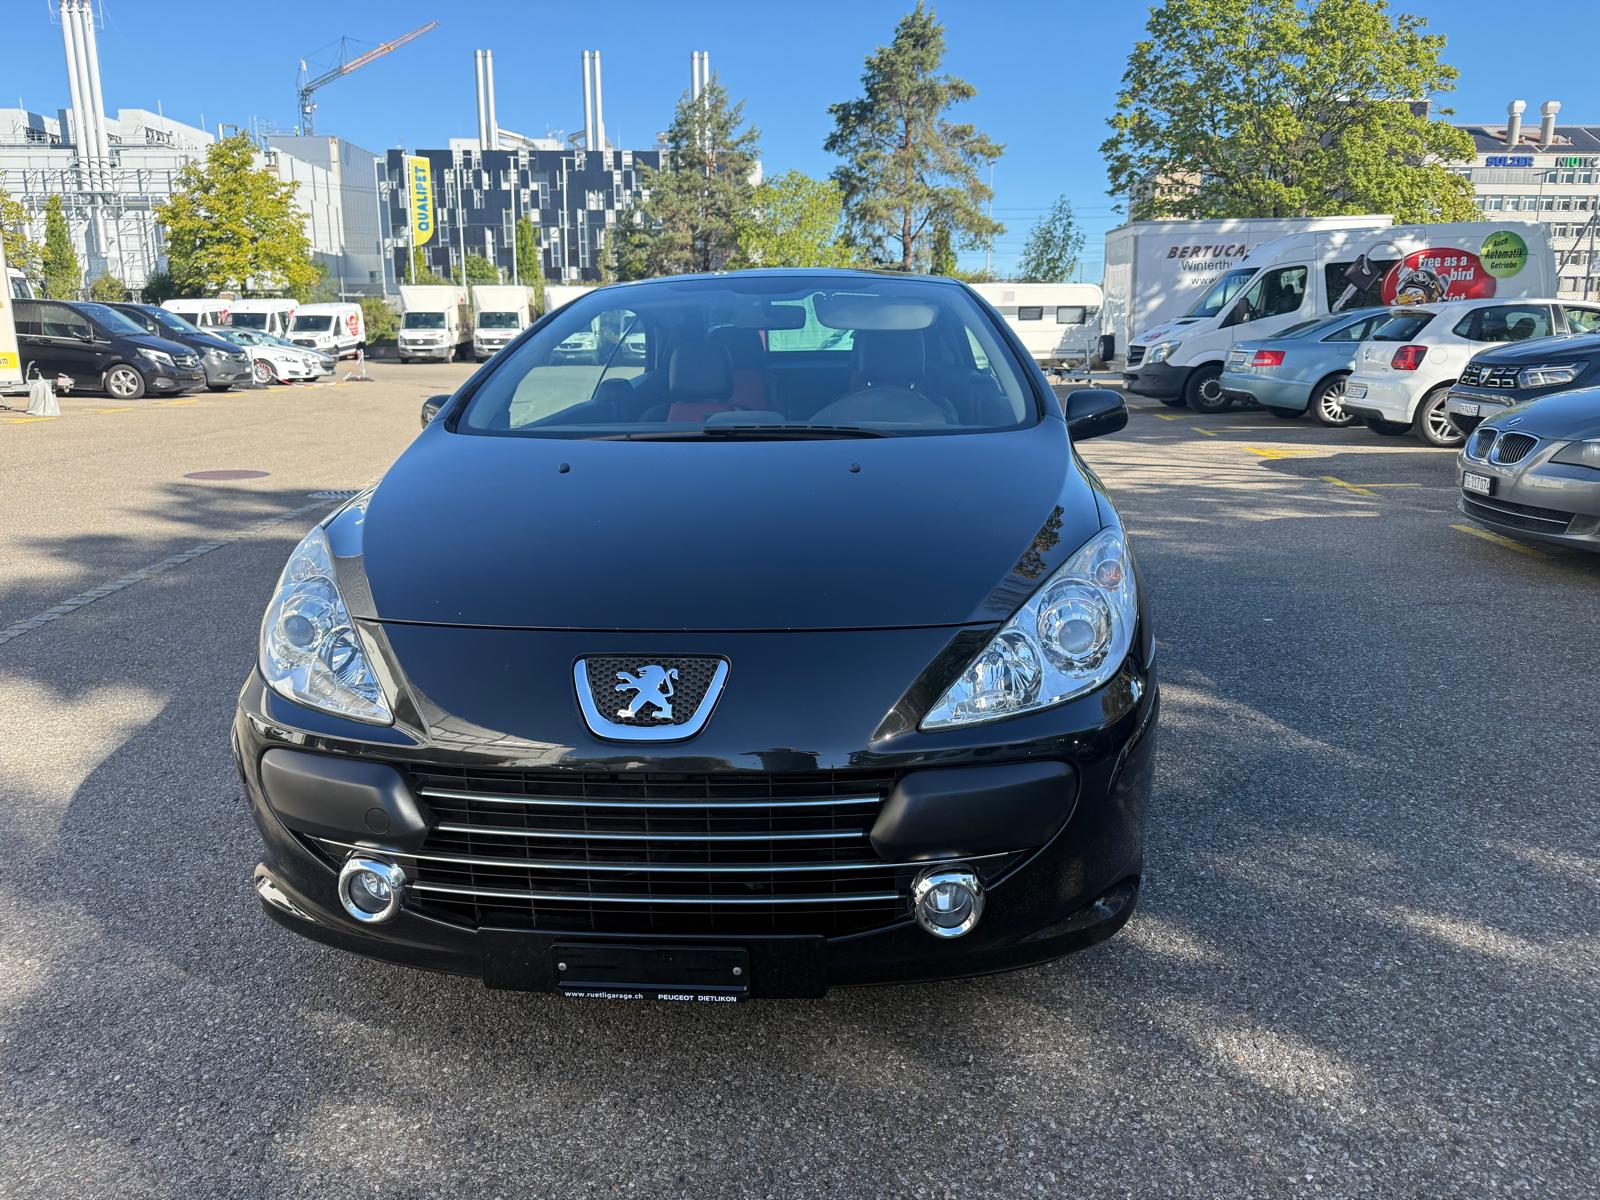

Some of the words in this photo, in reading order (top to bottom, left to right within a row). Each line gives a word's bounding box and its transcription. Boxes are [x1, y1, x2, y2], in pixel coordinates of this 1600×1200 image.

[1485, 155, 1535, 167] SULZER
[415, 166, 430, 231] QUALIPET
[1493, 237, 1509, 247] Auch
[1484, 248, 1524, 259] Automatik
[1418, 255, 1441, 269] Free
[1443, 256, 1458, 267] as
[1460, 256, 1468, 266] a
[1490, 261, 1518, 269] Getriebe
[1450, 267, 1475, 281] bird
[565, 991, 643, 1000] www.ruetligarage.ch
